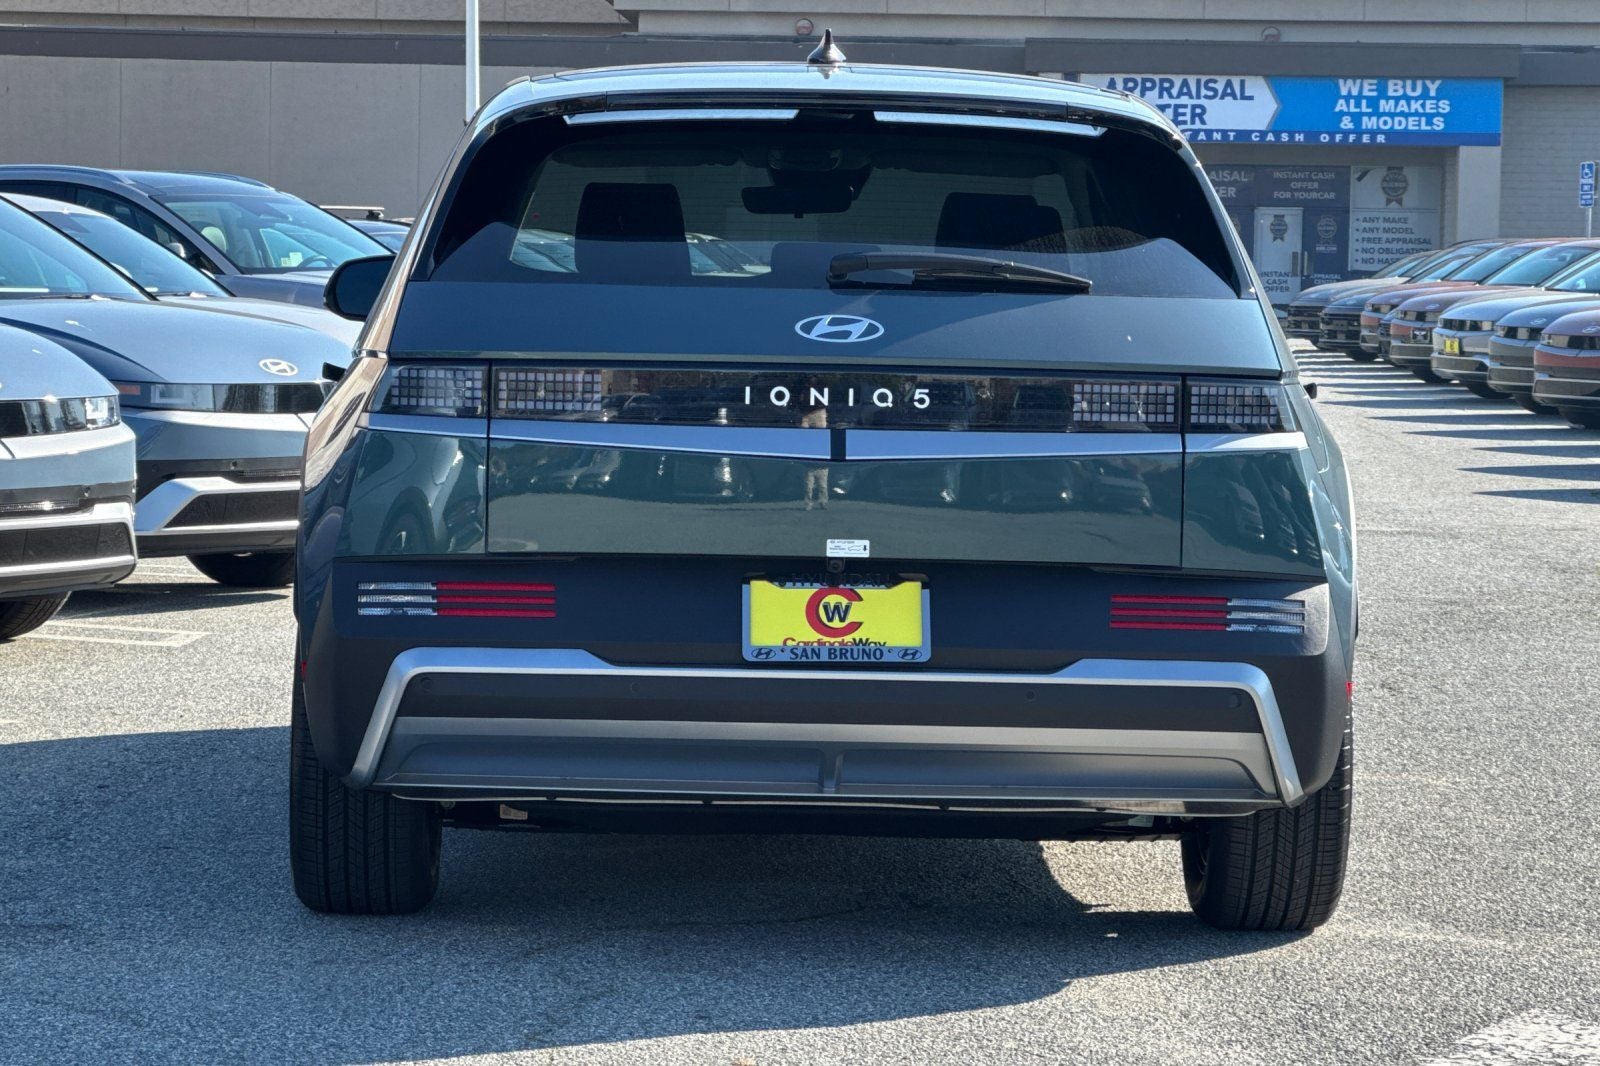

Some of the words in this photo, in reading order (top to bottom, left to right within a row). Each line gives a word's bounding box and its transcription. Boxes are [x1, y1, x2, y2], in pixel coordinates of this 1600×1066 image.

[1106, 77, 1254, 100] APPRAISAL
[1338, 79, 1378, 96] WE
[1387, 79, 1442, 97] BUY
[1334, 99, 1372, 113] ALL
[1379, 100, 1451, 114] MAKES
[1155, 103, 1207, 126] TER
[1339, 116, 1355, 130] &
[1362, 117, 1445, 131] MODELS
[1183, 131, 1236, 141] TANT
[1251, 132, 1304, 142] CASH
[1320, 133, 1386, 143] OFFER
[1209, 170, 1248, 182] AISAL
[1273, 171, 1309, 180] INSTANT
[1311, 172, 1335, 180] CASH
[1290, 181, 1319, 189] OFFER
[1273, 191, 1291, 199] FOR
[1361, 216, 1380, 224] ANY
[1383, 216, 1408, 224] MAKE
[1361, 227, 1380, 235] ANY
[1383, 227, 1415, 235] MODEL
[1361, 237, 1382, 245] FREE
[1385, 237, 1432, 245] APPRAISAL
[1361, 247, 1375, 255] NO
[1378, 247, 1432, 255] OBLIGATI
[1361, 257, 1375, 265] NO
[789, 647, 821, 661] SAN
[827, 647, 885, 661] BRUNO
